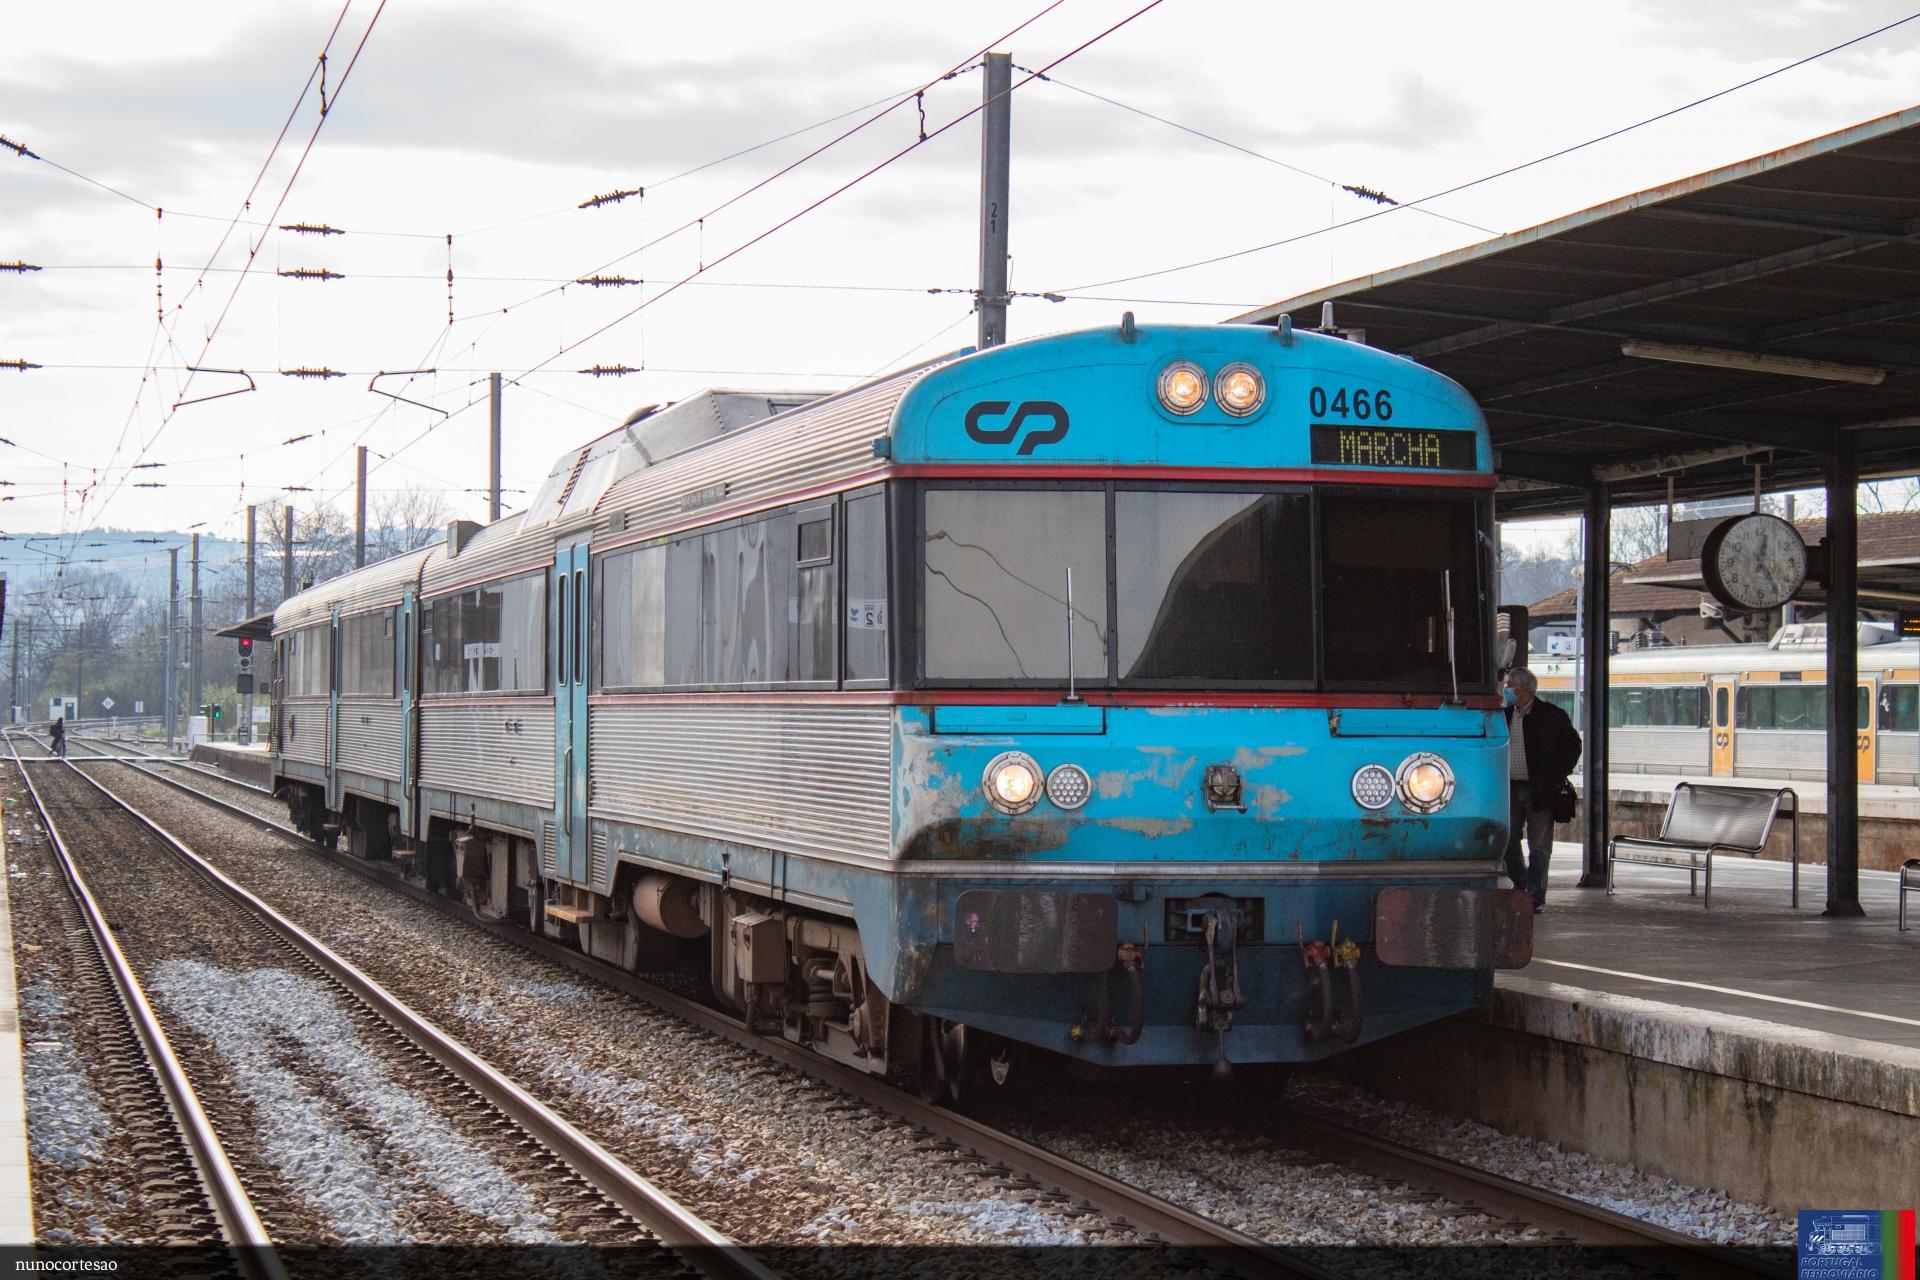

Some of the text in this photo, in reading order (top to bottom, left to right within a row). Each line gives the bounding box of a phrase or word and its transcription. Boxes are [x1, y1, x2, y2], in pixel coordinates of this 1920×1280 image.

[1309, 386, 1393, 421] 0466
[964, 401, 1070, 455] CP
[1340, 430, 1440, 466] MARCHA
